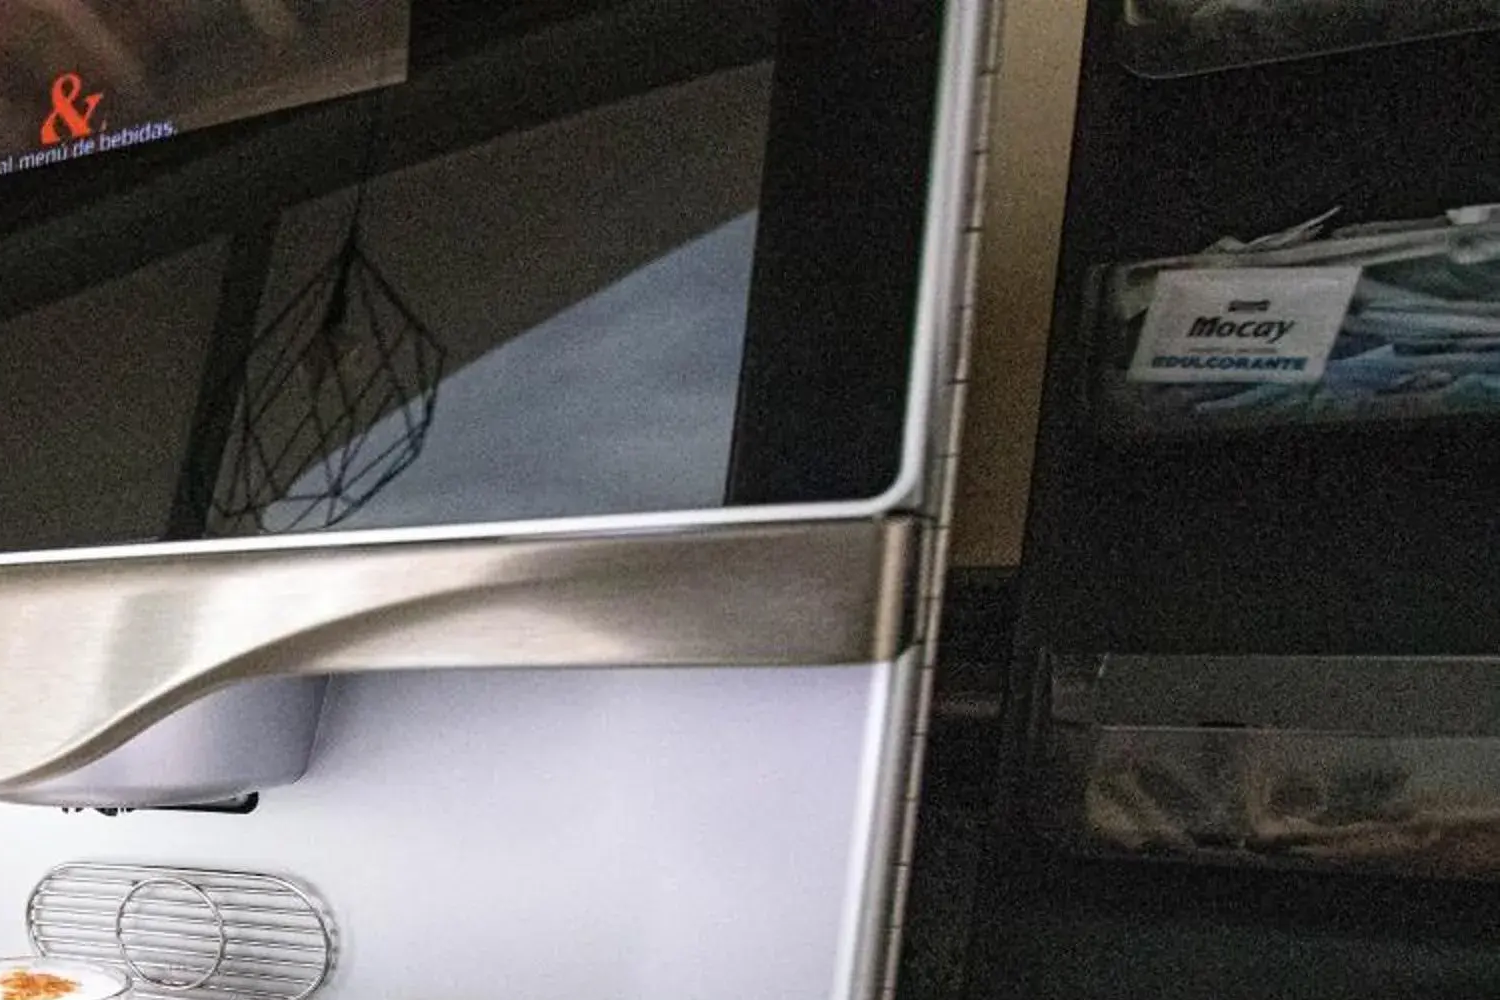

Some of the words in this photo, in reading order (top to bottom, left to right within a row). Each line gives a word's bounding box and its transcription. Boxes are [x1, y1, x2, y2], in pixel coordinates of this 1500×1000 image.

[41, 72, 104, 144] &
[73, 137, 96, 158] de
[1187, 315, 1296, 344] Mocay
[1152, 355, 1309, 371] EDULCORANTE
